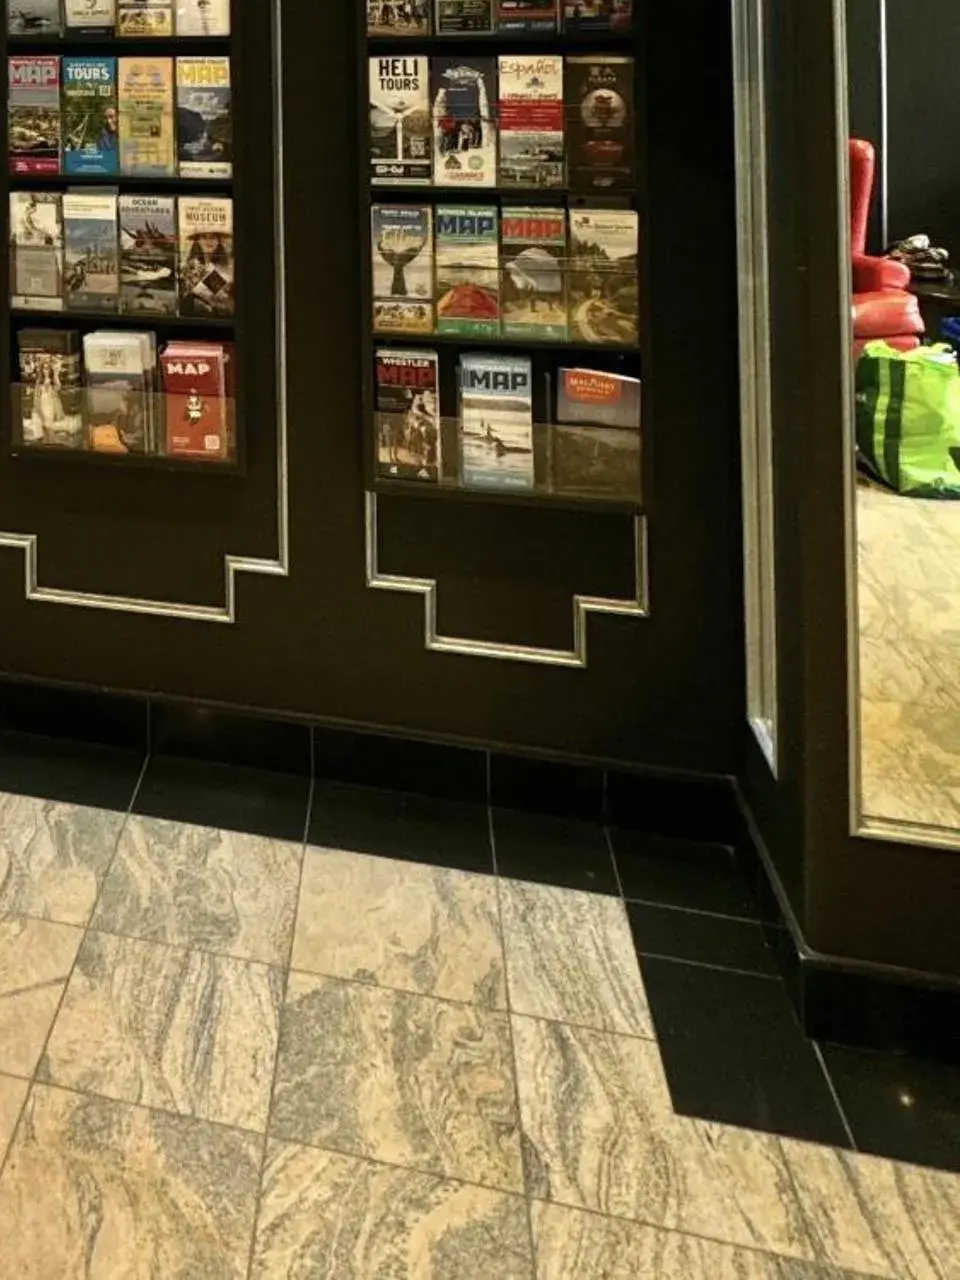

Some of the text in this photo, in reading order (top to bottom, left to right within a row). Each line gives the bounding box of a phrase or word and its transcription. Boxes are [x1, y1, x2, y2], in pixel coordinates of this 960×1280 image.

[8, 66, 56, 83] MAP
[66, 67, 110, 81] TOURS
[379, 59, 419, 77] HELI
[379, 78, 420, 91] TOURS
[437, 216, 493, 234] MAP
[503, 219, 563, 238] MAP
[167, 362, 211, 376] MAP
[382, 358, 430, 368] WHISTLER
[379, 367, 434, 386] MAP
[469, 370, 528, 390] MAP
